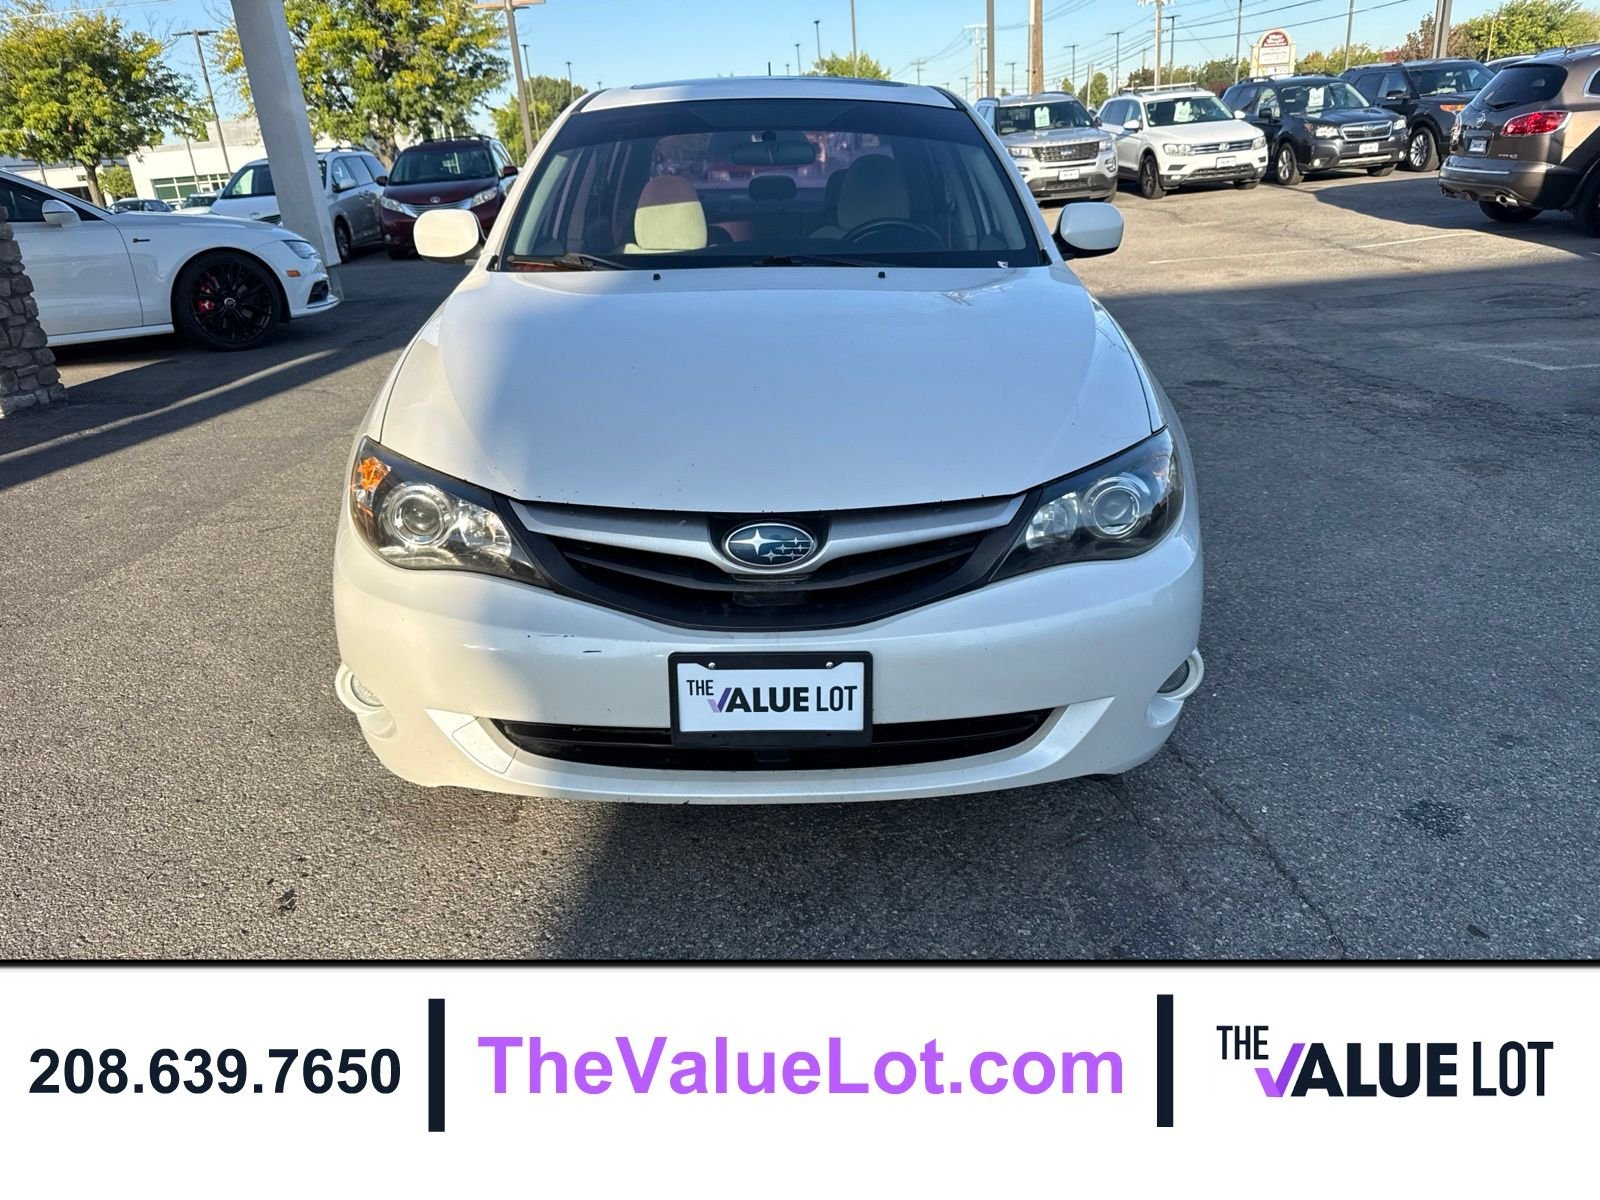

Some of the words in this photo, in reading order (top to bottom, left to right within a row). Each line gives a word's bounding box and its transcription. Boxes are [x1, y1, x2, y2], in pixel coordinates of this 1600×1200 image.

[686, 679, 714, 696] THE
[707, 686, 809, 713] VALUE
[815, 684, 858, 712] LOT
